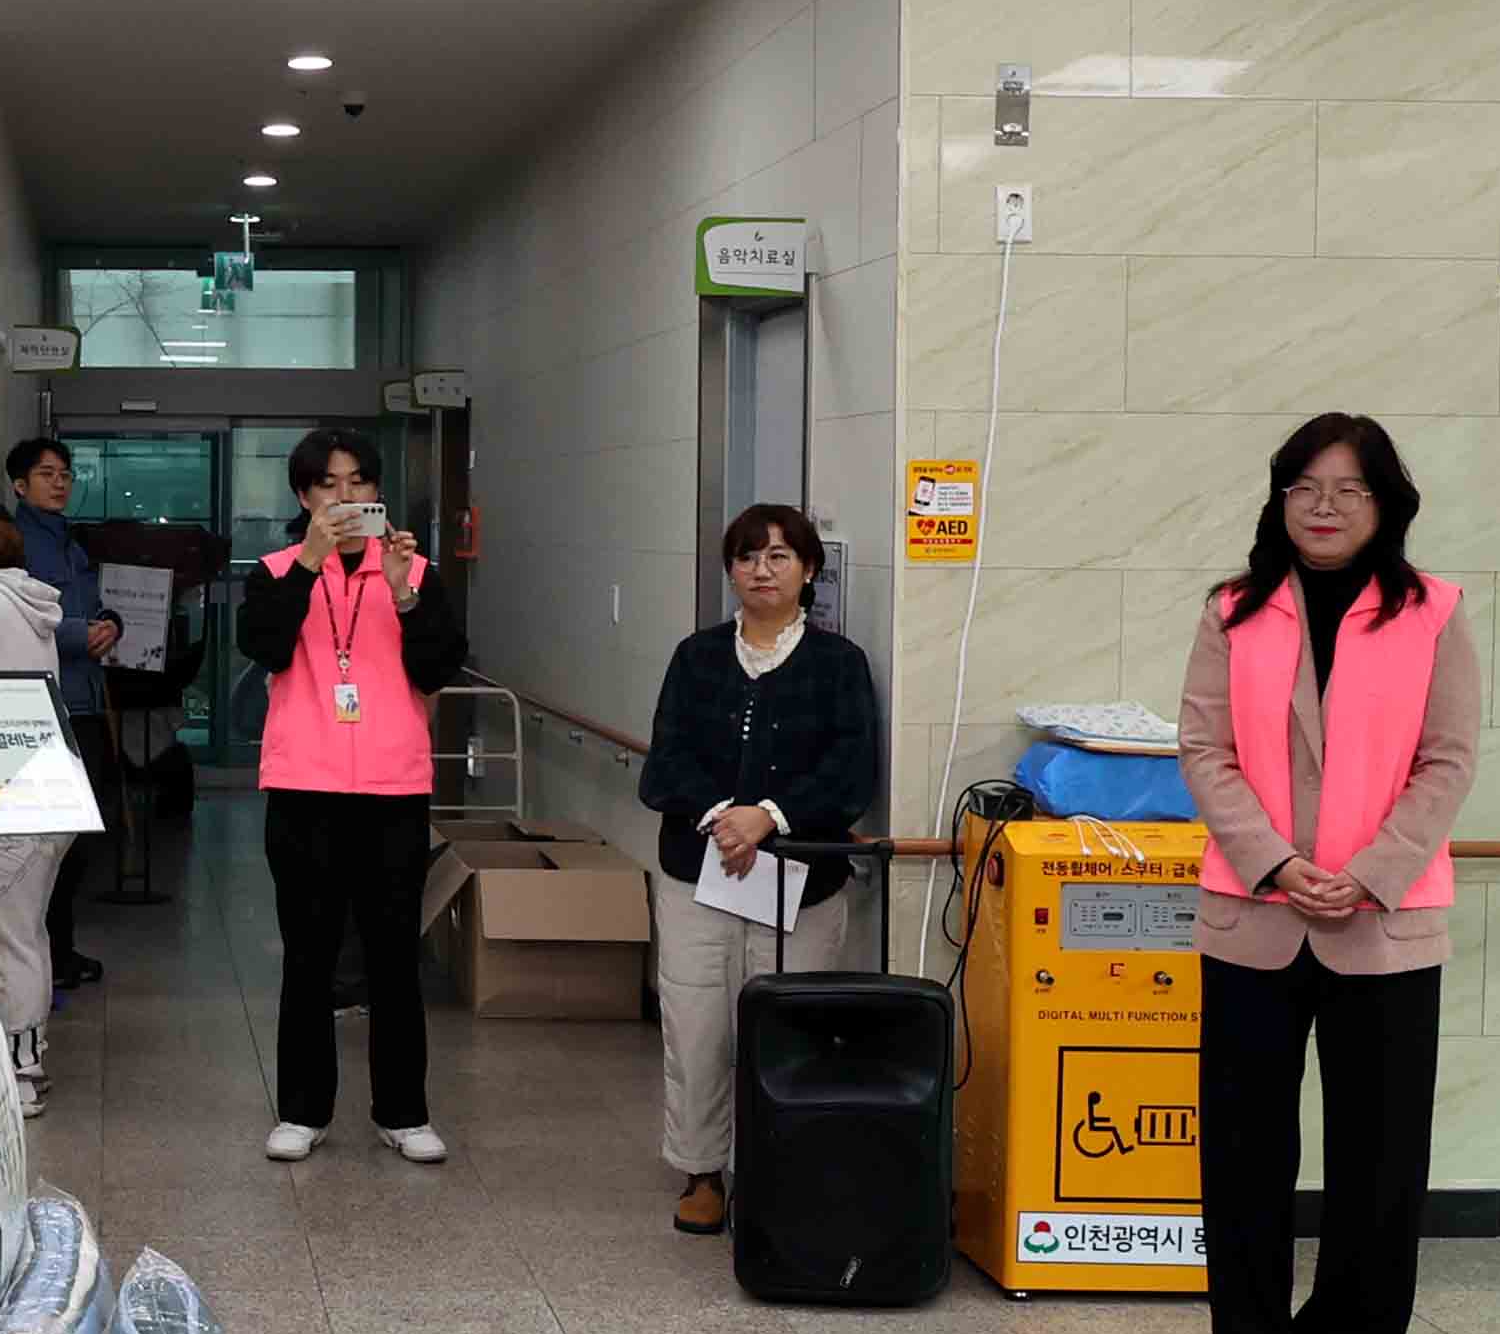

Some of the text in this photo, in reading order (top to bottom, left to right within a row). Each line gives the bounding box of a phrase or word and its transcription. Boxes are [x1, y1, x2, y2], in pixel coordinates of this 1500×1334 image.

[717, 248, 795, 266] 음악치료실
[936, 520, 968, 536] AED
[1041, 860, 1112, 877] 전동휠체어
[1038, 1010, 1083, 1020] DIGITAL
[1088, 1011, 1124, 1021] MULTI
[1127, 1012, 1187, 1022] FUNCTION
[1064, 1223, 1182, 1254] 인천광역시
